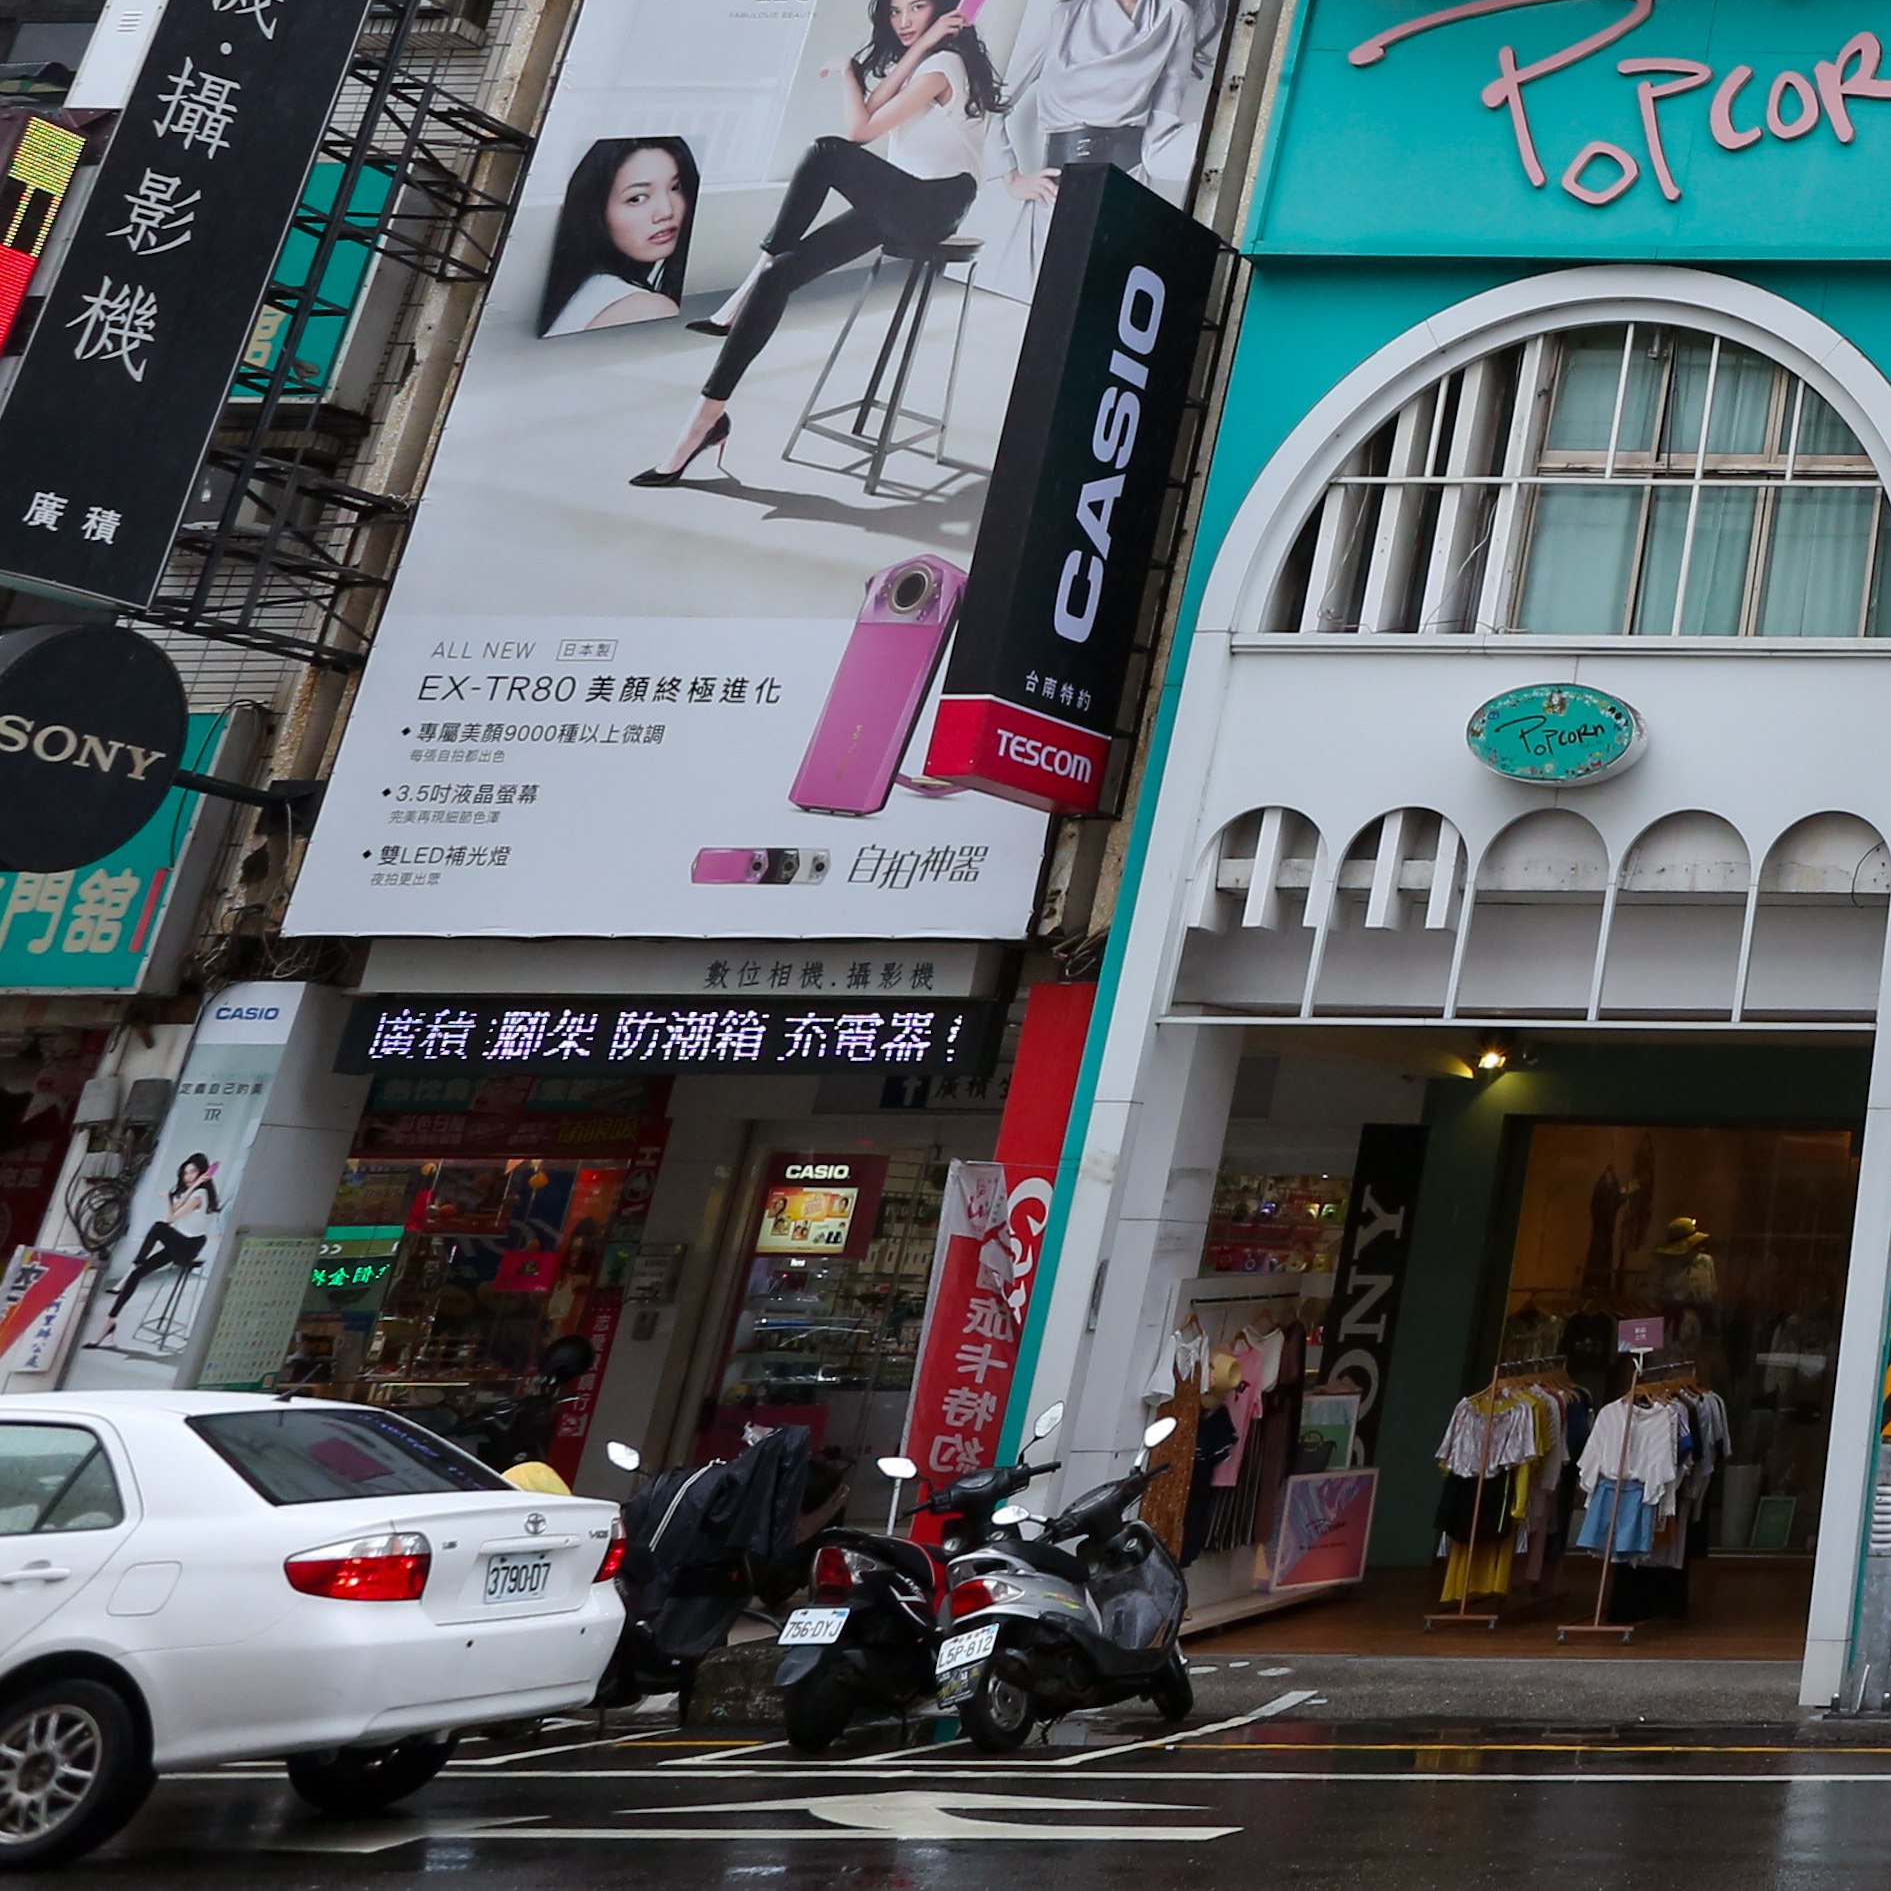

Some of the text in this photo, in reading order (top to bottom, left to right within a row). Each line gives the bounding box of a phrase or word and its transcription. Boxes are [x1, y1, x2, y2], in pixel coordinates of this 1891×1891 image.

[1053, 264, 1167, 644] CASIO
[431, 640, 473, 660] ALL
[482, 640, 537, 660] NEW
[417, 674, 784, 706] EX-TR80 美顏終極進化
[0, 713, 166, 782] SONY
[997, 728, 1093, 784] TESCOM
[215, 1005, 280, 1021] CASIO
[785, 1164, 850, 1179] CASIO
[782, 1620, 843, 1639] 756-DYJ
